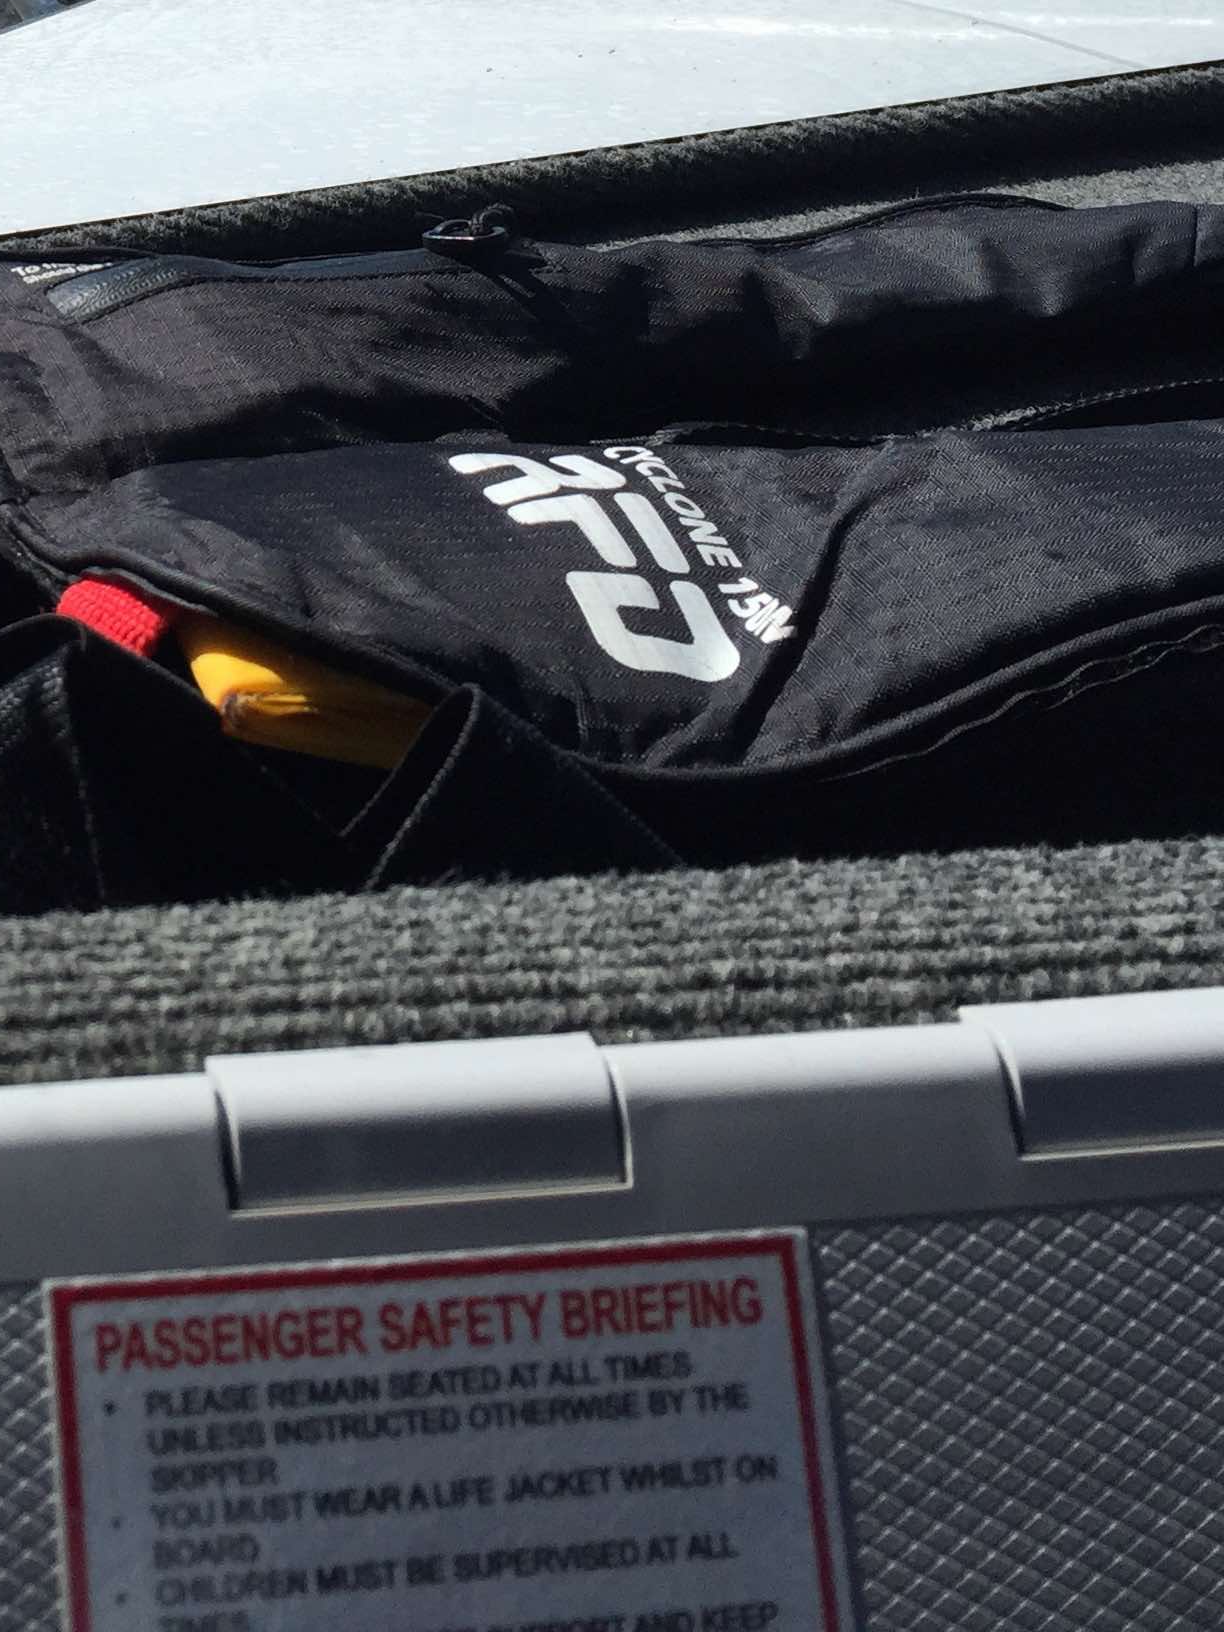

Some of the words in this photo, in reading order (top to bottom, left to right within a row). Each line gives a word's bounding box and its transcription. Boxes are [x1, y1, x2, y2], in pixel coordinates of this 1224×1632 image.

[603, 445, 743, 569] CYCLONE
[94, 1307, 367, 1372] PASSENGER
[378, 1290, 548, 1353] SAFETY
[559, 1275, 764, 1340] BRIEFING
[144, 1382, 260, 1417] PLEASE
[266, 1374, 381, 1409] REMAIN
[387, 1363, 502, 1400] SEATED
[508, 1361, 543, 1388] AT
[549, 1359, 599, 1386] ALL
[604, 1350, 693, 1381] TIMES
[147, 1420, 266, 1455] UNLESS
[273, 1405, 462, 1445] INSTRUCTED
[467, 1391, 642, 1430] OTHERWISE
[647, 1386, 688, 1415] BY
[691, 1382, 750, 1412] THE
[151, 1501, 217, 1529] YOU
[313, 1483, 402, 1517] WEAR
[407, 1483, 430, 1510] A
[433, 1477, 495, 1508] LIFE
[503, 1465, 614, 1503] JACKET
[620, 1456, 727, 1490] WHILST
[734, 1453, 779, 1483] ON
[315, 1559, 396, 1595] MUST
[406, 1552, 444, 1584] BE
[452, 1539, 641, 1582] SUPERVISED
[646, 1535, 681, 1563] AT
[687, 1531, 740, 1559] ALL
